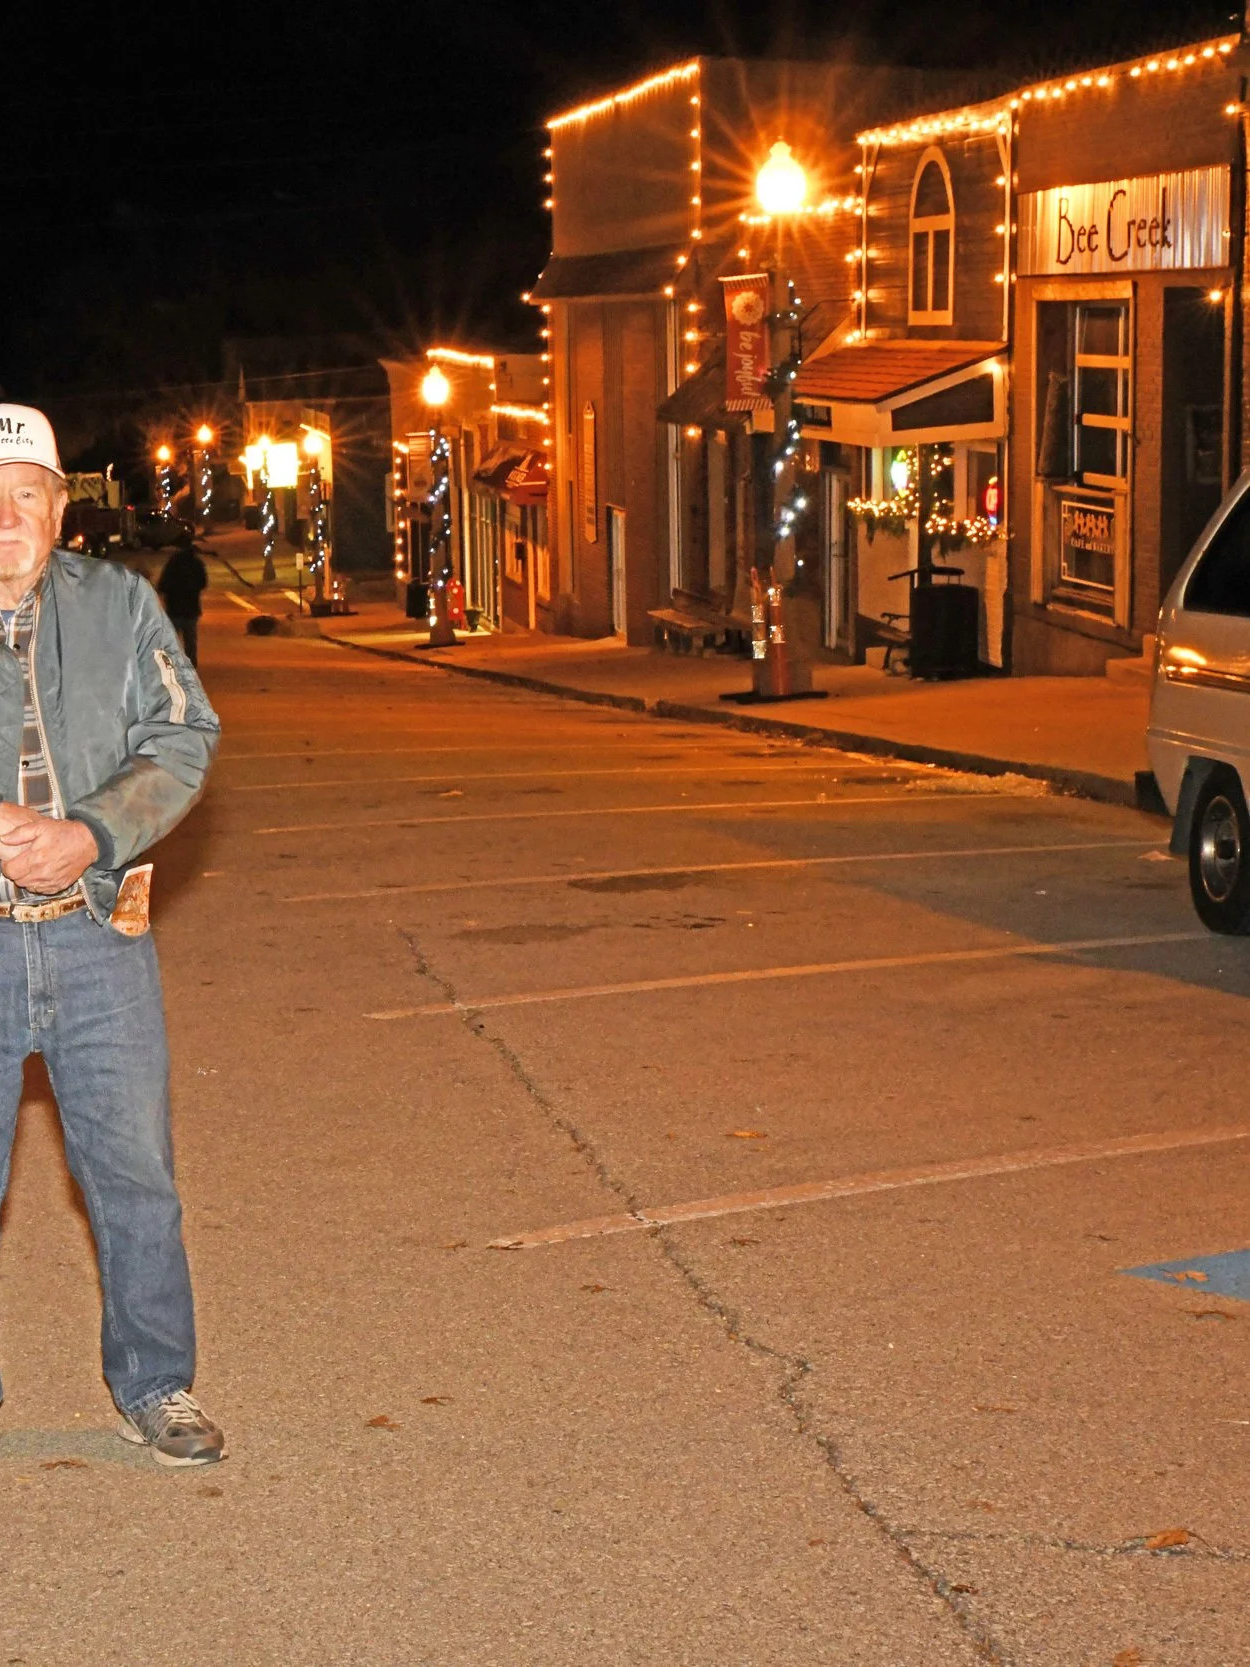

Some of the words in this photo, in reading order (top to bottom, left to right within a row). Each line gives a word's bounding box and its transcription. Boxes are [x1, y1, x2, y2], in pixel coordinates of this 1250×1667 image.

[1056, 198, 1099, 265] Bee
[1107, 188, 1172, 262] Creek
[739, 331, 762, 351] be
[733, 352, 762, 396] joyful
[16, 436, 33, 446] City
